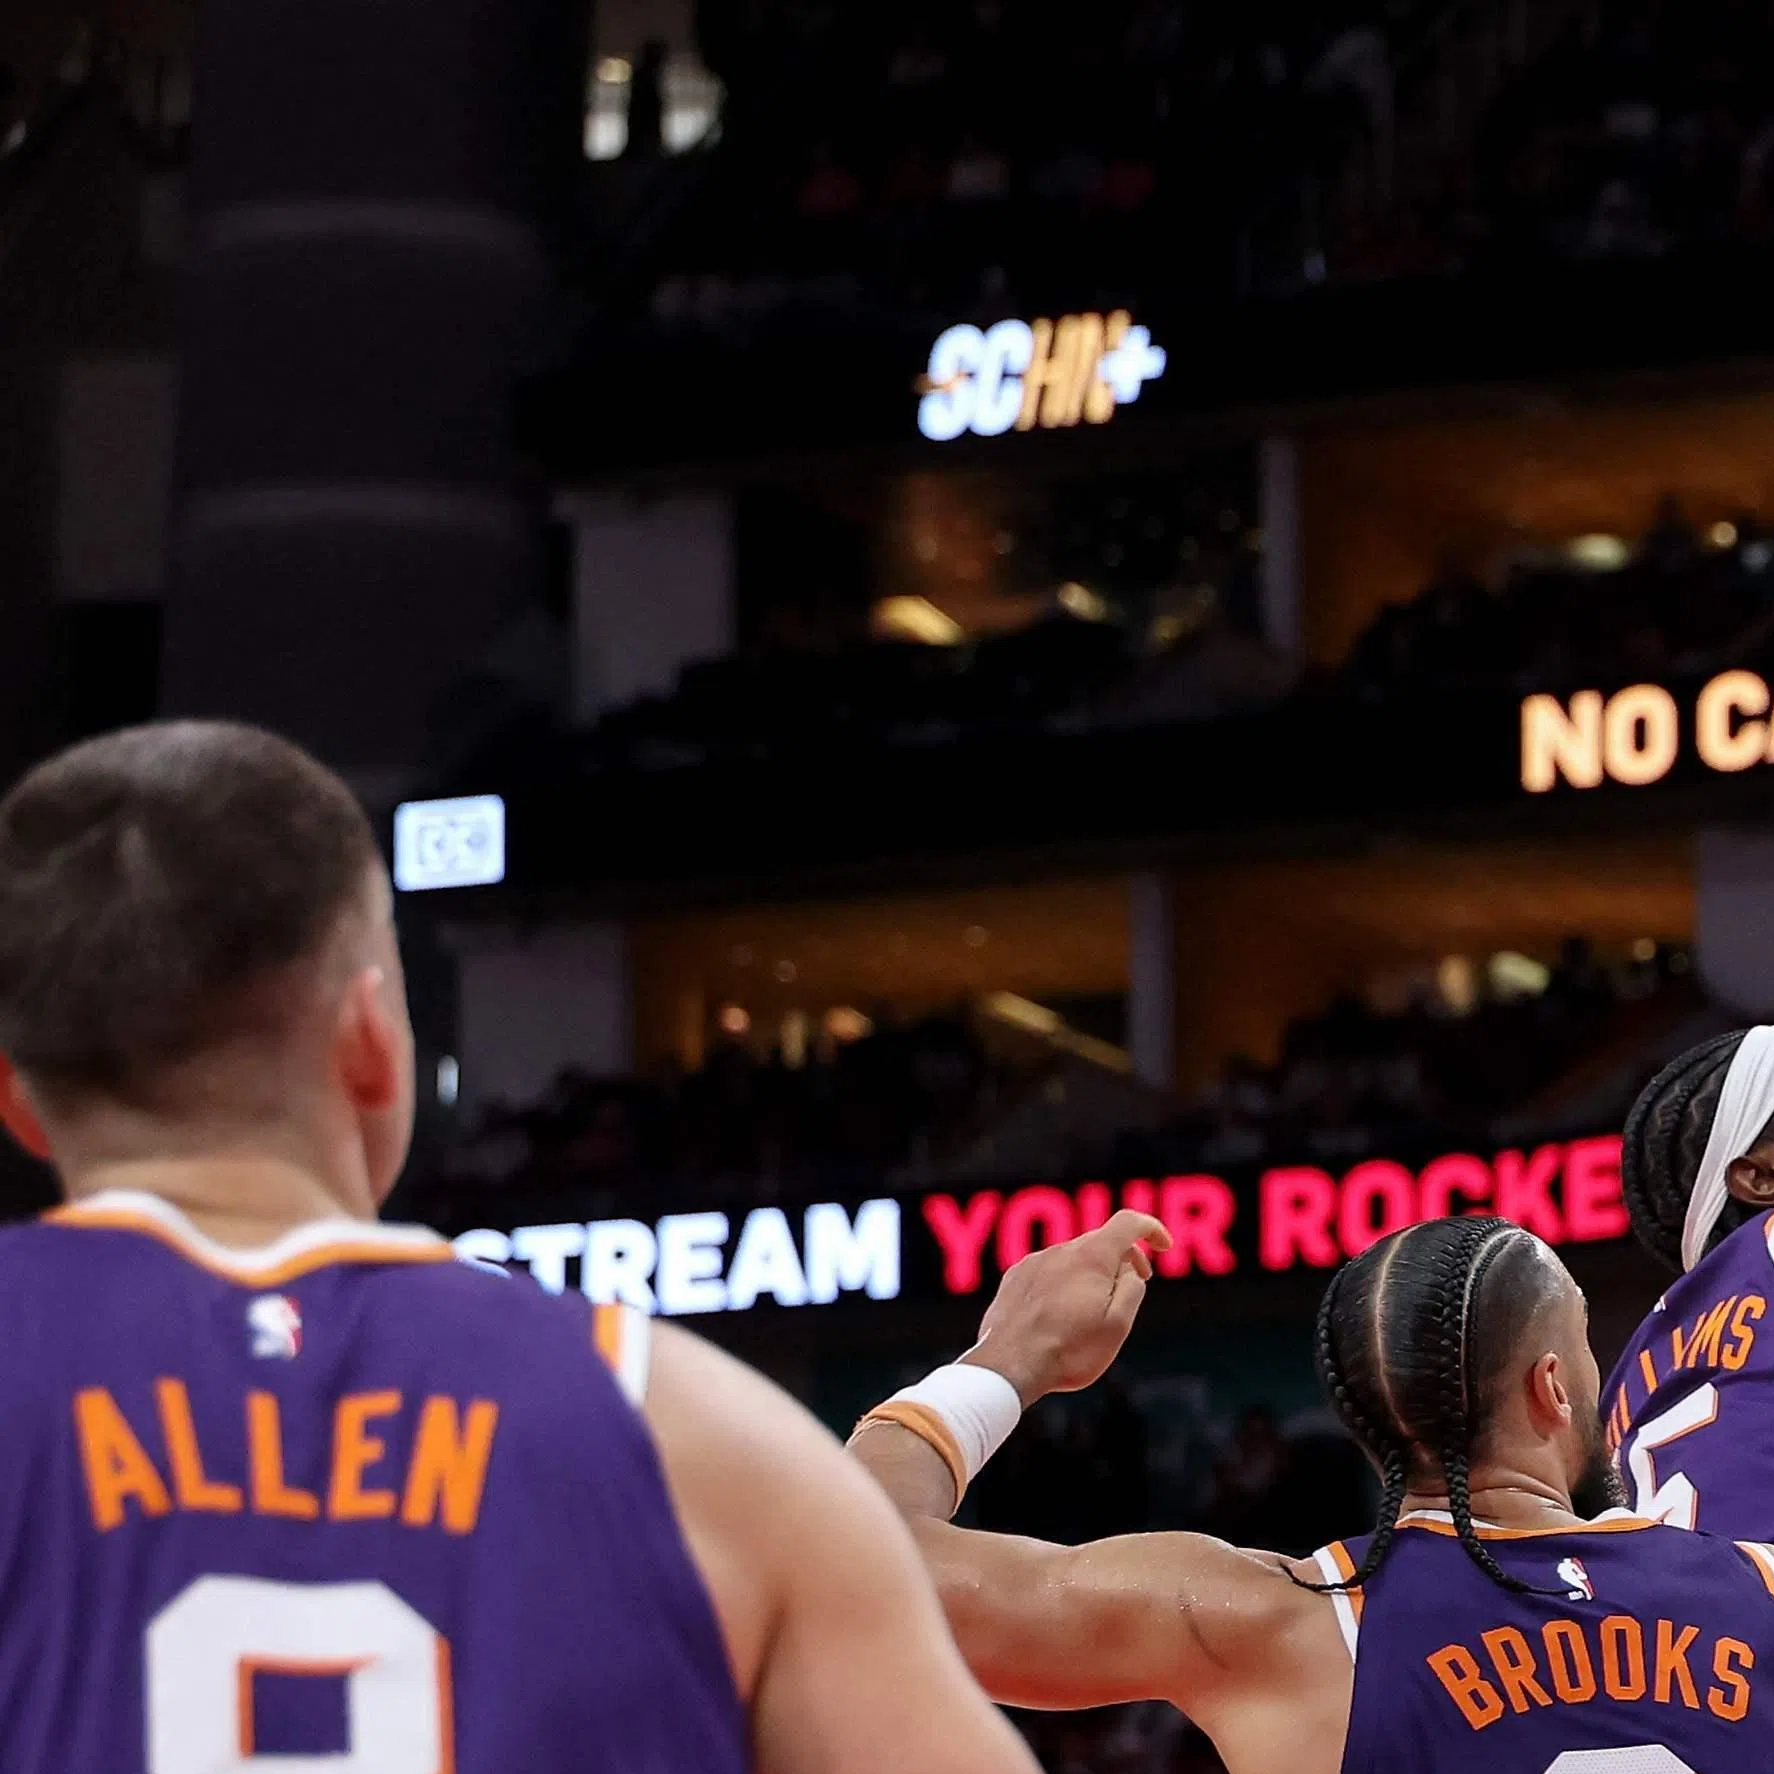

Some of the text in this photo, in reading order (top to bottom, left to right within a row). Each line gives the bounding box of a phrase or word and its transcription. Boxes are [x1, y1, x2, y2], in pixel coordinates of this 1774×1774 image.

[1519, 682, 1680, 793] NO
[73, 1376, 498, 1535] ALLEN
[1426, 1614, 1755, 1731] BROOKS
